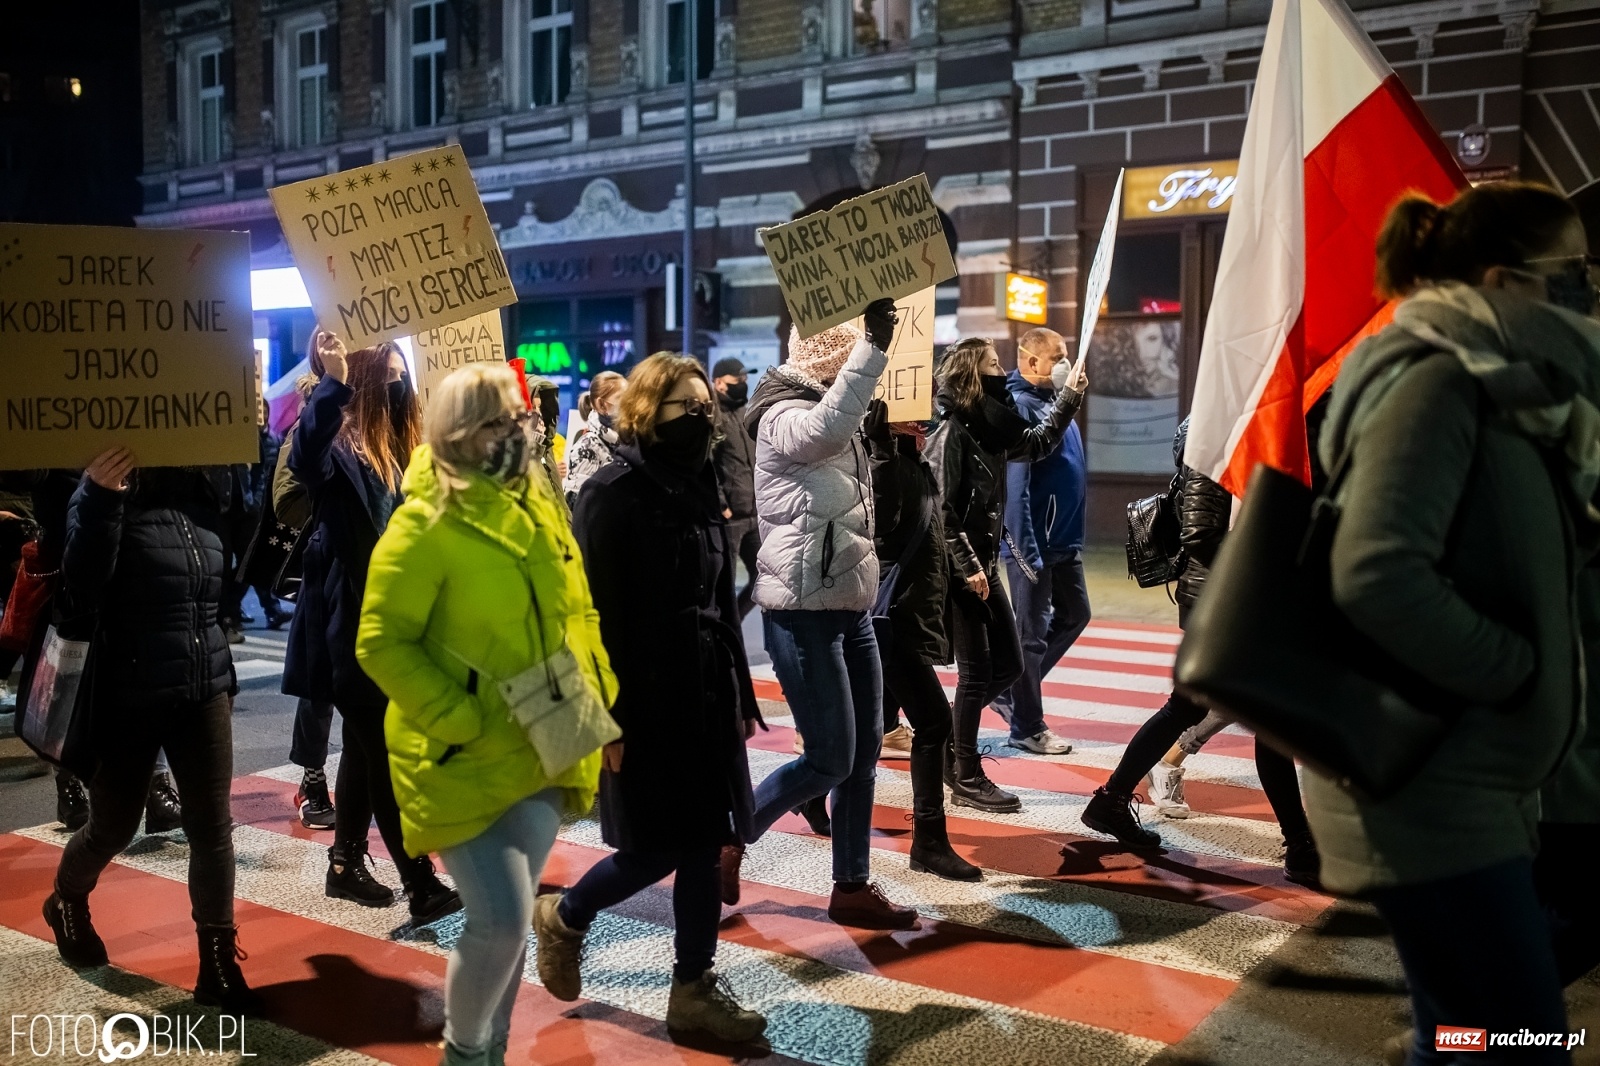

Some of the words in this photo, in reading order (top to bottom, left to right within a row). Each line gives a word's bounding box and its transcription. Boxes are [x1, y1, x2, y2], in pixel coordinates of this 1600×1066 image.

[1147, 167, 1238, 212] Fry
[301, 202, 368, 242] POZA
[767, 216, 841, 264] JAREK,
[836, 205, 868, 237] TO
[870, 182, 935, 224] TWOJA
[57, 255, 155, 286] JAREK
[350, 237, 407, 281] MAM
[778, 253, 839, 292] WINA,
[834, 232, 898, 272] TWOJA
[897, 214, 942, 248] BARDZO
[337, 286, 410, 341] MÓZG
[407, 280, 424, 319] I
[790, 275, 869, 328] WIELKA
[870, 256, 918, 294] WINA
[0, 299, 126, 333] KOBIETA
[136, 299, 174, 332] TO
[184, 299, 228, 333] NIE
[416, 324, 493, 347] CHOWA
[63, 348, 158, 381] JAJKO
[872, 365, 925, 401] BIET
